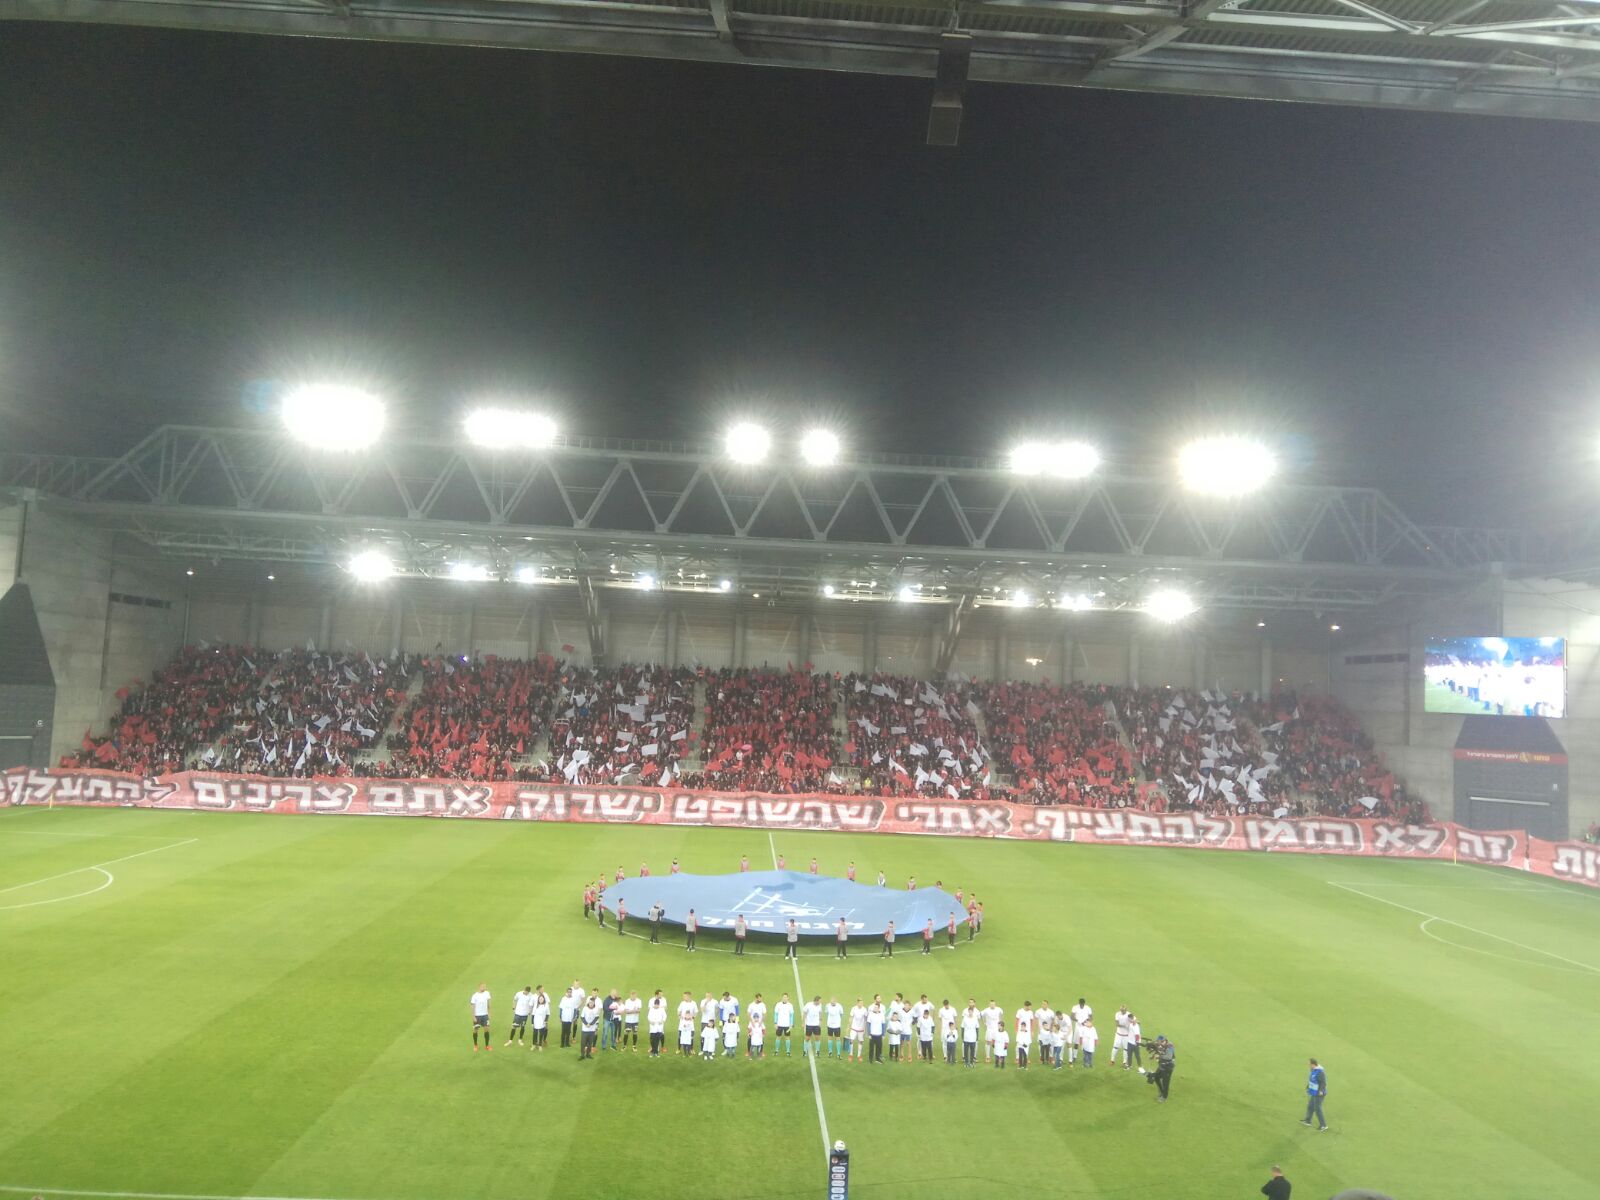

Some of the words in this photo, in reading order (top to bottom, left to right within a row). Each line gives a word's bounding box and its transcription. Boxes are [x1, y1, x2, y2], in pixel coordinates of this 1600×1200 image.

[193, 780, 347, 808] צריכים
[369, 785, 484, 810] אתם
[503, 792, 653, 819] ישרוק,
[675, 796, 872, 825] שהשופט
[900, 805, 1003, 829] אחרי
[1246, 820, 1354, 848] הזמן
[1376, 824, 1440, 850] לא
[1457, 832, 1507, 859] זה
[1552, 848, 1600, 879] ות
